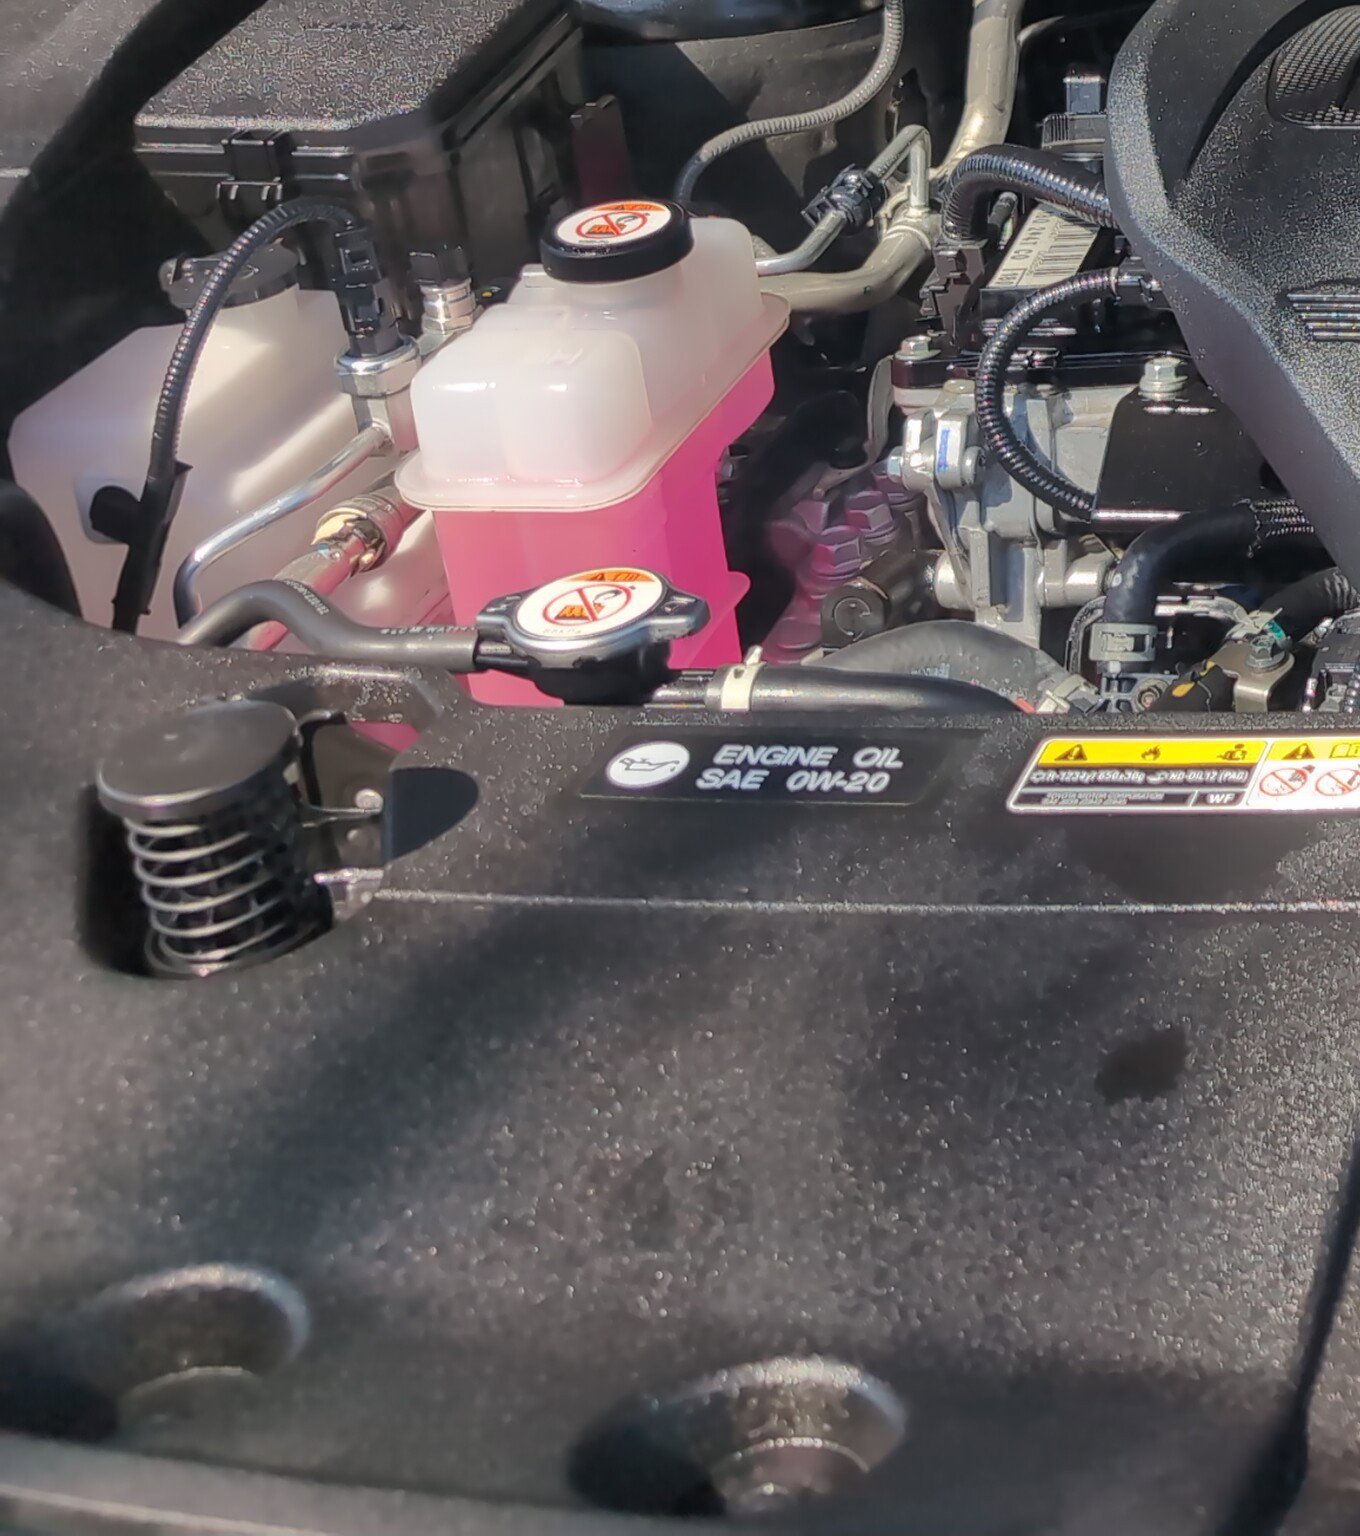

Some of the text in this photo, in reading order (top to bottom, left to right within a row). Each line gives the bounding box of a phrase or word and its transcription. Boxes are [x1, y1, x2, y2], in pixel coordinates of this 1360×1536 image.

[713, 744, 904, 769] ENGINE OIL
[696, 768, 891, 792] SAE 0W-20
[1208, 792, 1236, 804] WF
